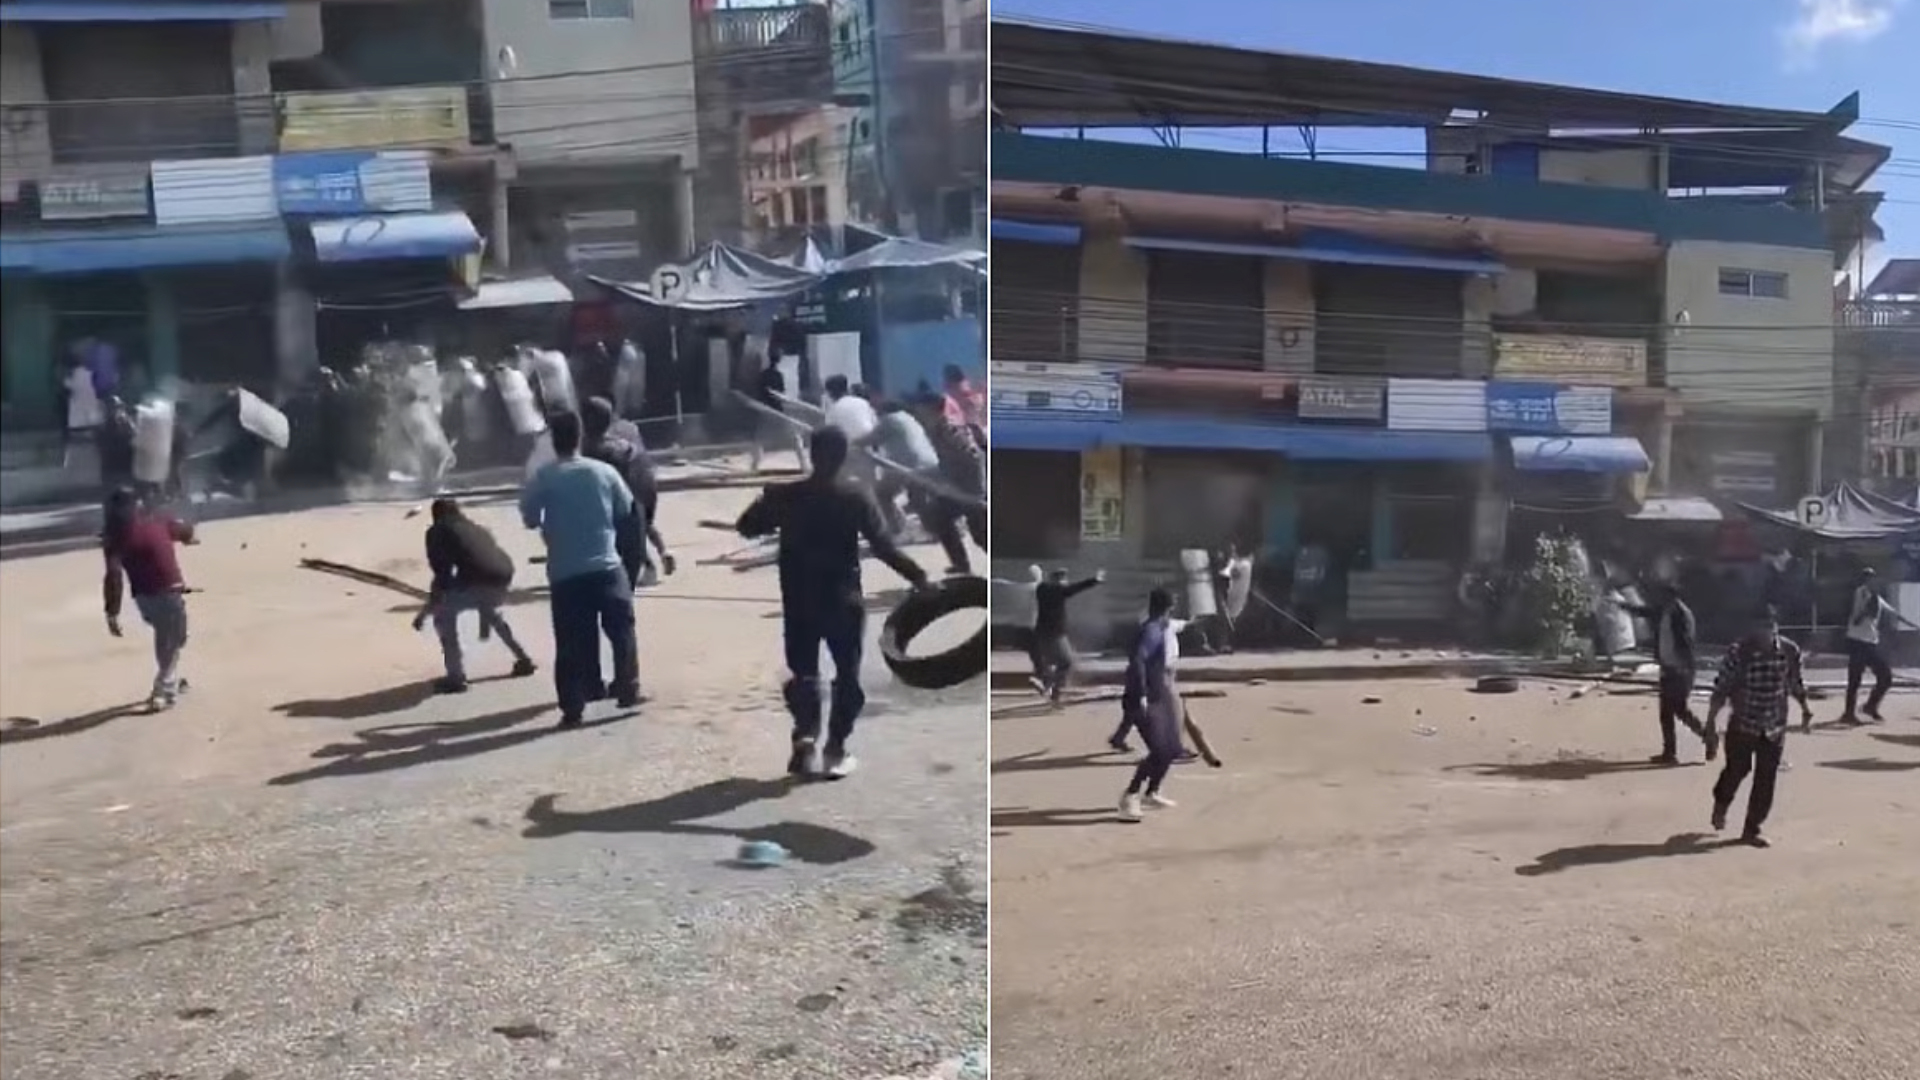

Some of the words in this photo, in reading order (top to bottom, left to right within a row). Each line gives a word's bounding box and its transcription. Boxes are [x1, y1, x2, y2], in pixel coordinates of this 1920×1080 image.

[660, 271, 680, 300] P
[1302, 387, 1345, 406] ATM
[1805, 500, 1824, 524] P
